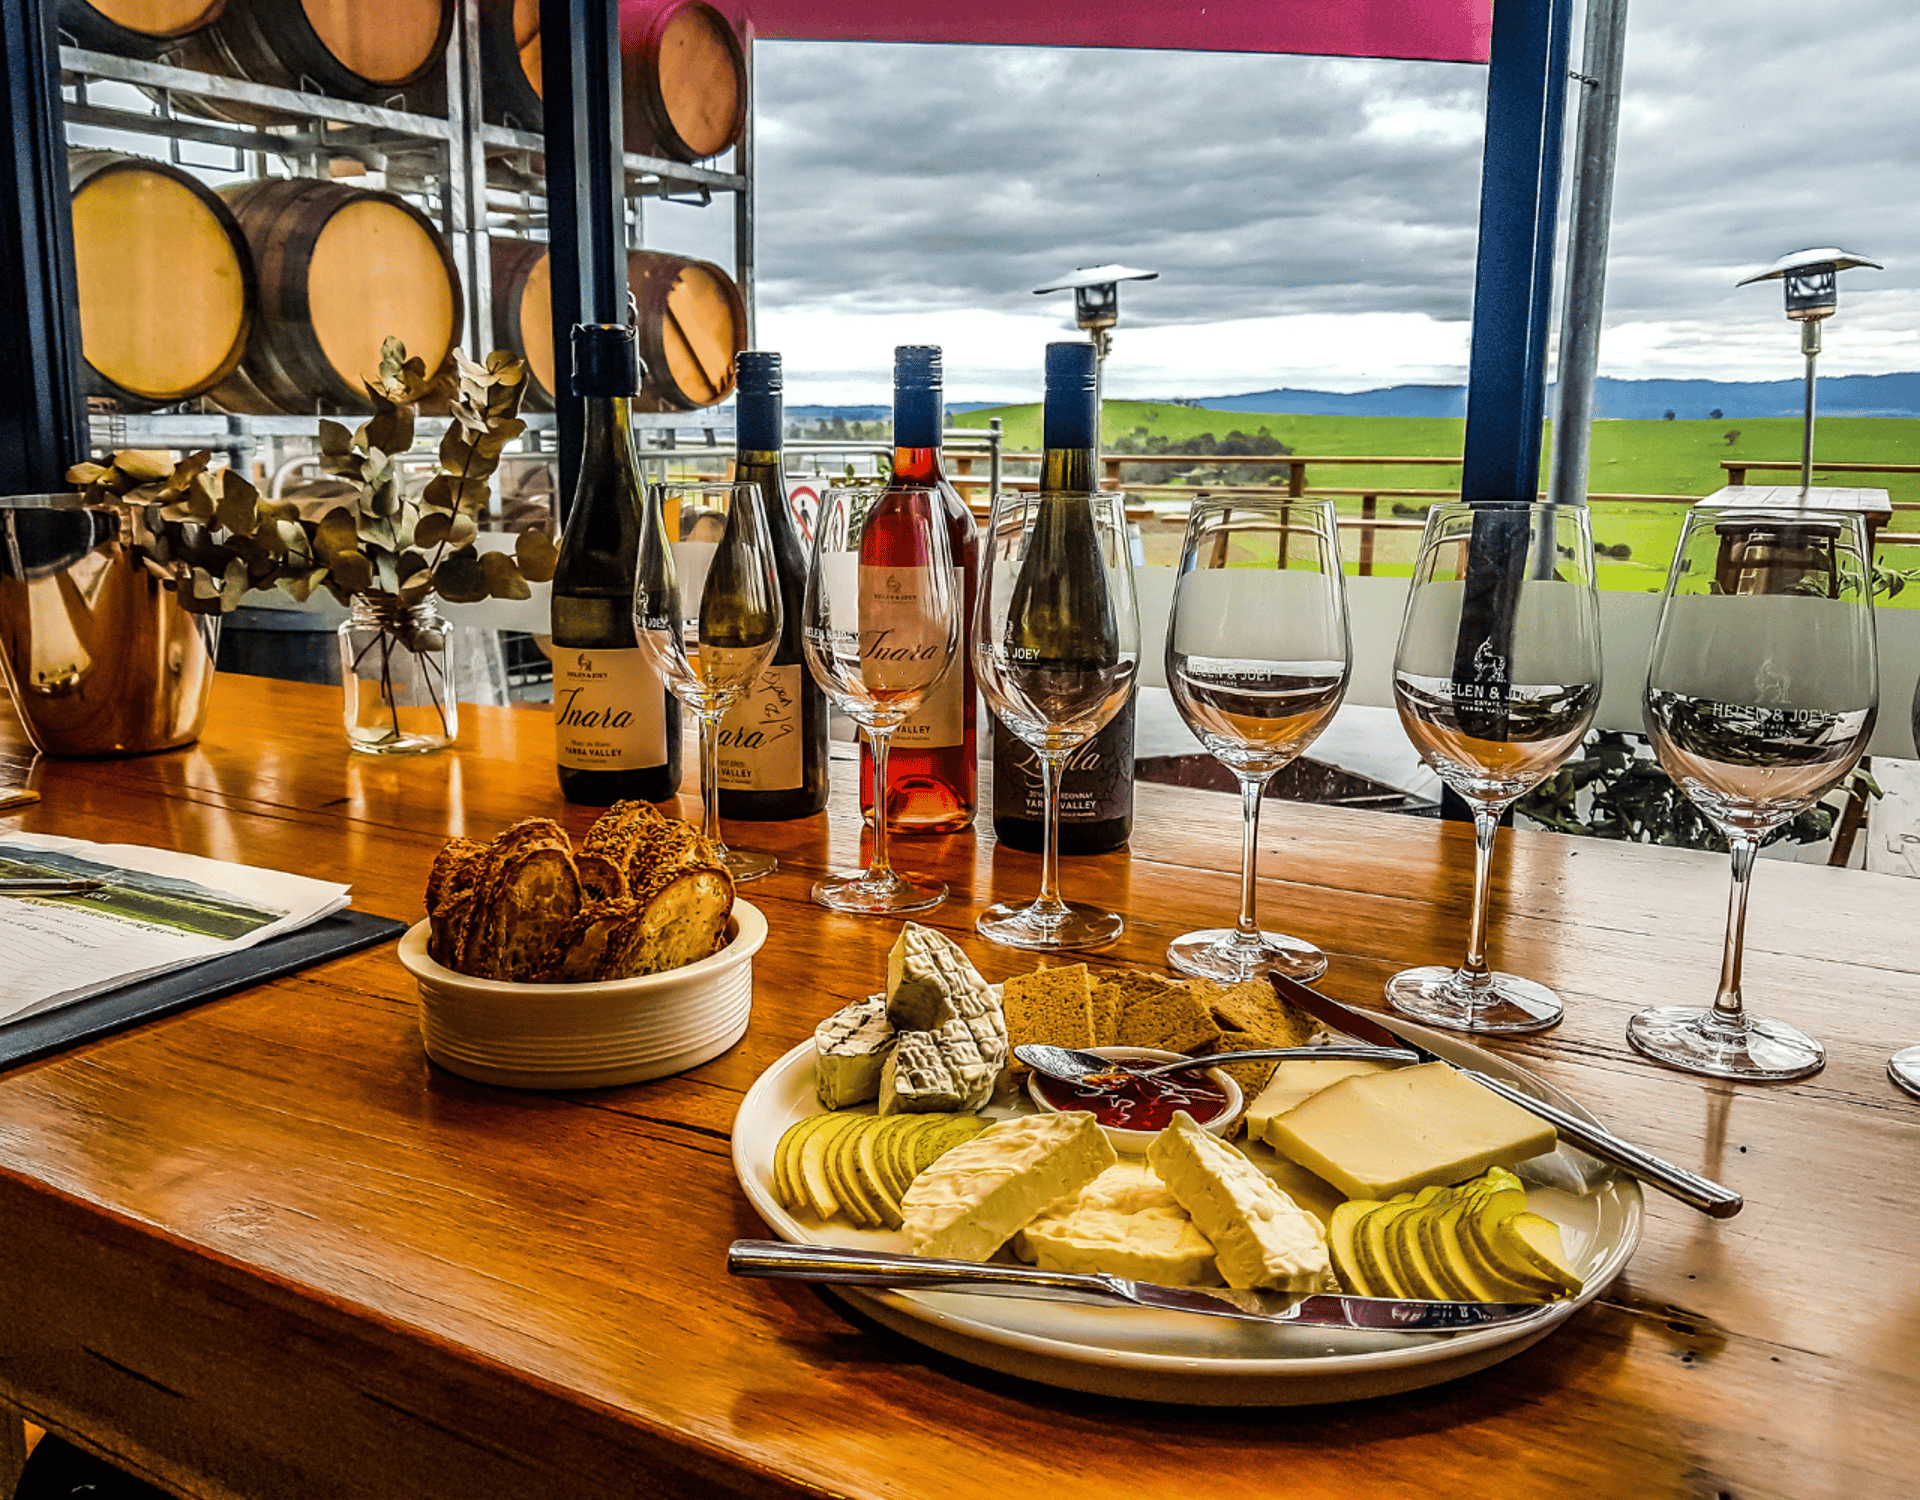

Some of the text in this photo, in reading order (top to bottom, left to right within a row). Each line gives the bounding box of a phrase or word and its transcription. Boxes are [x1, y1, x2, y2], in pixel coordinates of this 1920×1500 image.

[863, 628, 938, 661] Inara
[1012, 647, 1041, 661] JOEY
[1227, 667, 1238, 680] &
[1241, 668, 1275, 682] JOEY
[1438, 681, 1485, 699] HELEN
[1489, 686, 1501, 700] &
[556, 687, 635, 728] Inara
[1712, 702, 1829, 723] HELEN & JOEY
[717, 726, 768, 749] ara
[895, 725, 931, 735] VALLEY
[588, 748, 623, 757] VALLEY
[1008, 737, 1102, 788] Lla
[721, 767, 752, 778] VALLEY
[1025, 798, 1096, 810] YAR VALLEY
